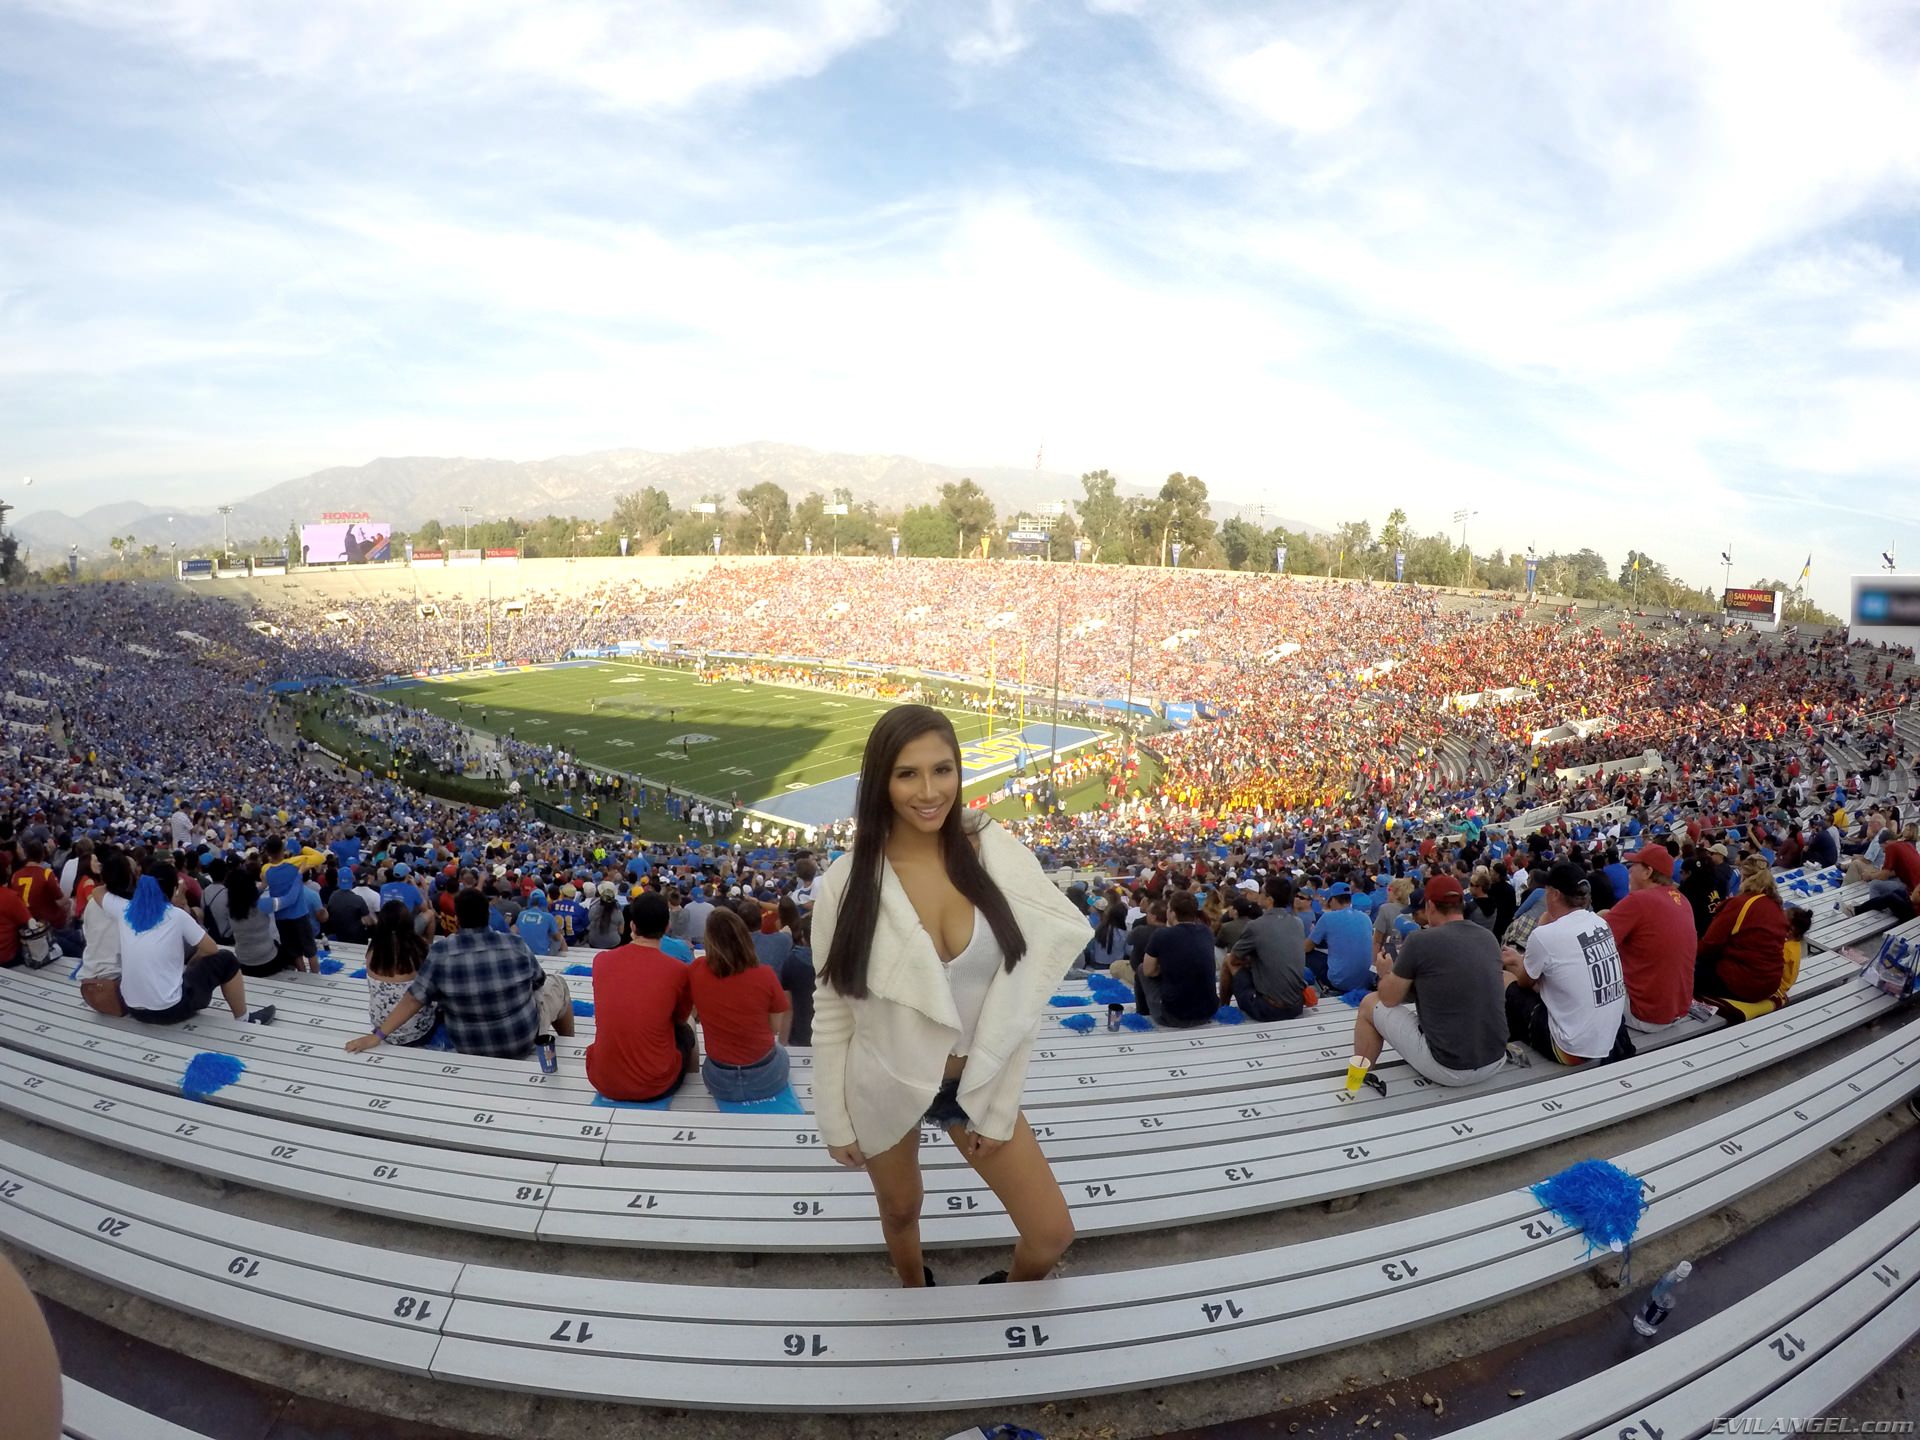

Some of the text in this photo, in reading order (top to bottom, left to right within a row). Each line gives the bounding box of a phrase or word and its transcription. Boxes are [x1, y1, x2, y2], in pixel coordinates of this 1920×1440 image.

[1734, 592, 1773, 603] SAN MANUEL
[18, 877, 33, 907] 7
[554, 903, 575, 913] UCLA
[239, 1035, 257, 1043] 23
[296, 1044, 314, 1053] 22
[1320, 1050, 1337, 1058] 10
[142, 1053, 161, 1063] 23
[366, 1056, 385, 1064] 21
[1246, 1060, 1263, 1068] 11
[441, 1065, 462, 1075] 20
[1168, 1069, 1188, 1078] 12
[23, 1077, 44, 1088] 23
[528, 1075, 548, 1084] 19
[1078, 1077, 1097, 1085] 13
[1619, 1080, 1633, 1089] 9
[284, 1083, 306, 1095] 21
[1335, 1091, 1355, 1102] 11
[93, 1099, 117, 1112] 22
[368, 1098, 392, 1110] 20
[1541, 1100, 1564, 1112] 10
[473, 1112, 495, 1124] 19
[1238, 1107, 1262, 1119] 12
[1793, 1110, 1809, 1121] 9
[1140, 1117, 1164, 1128] 13
[175, 1123, 200, 1136] 21
[580, 1125, 604, 1137] 18
[672, 1130, 697, 1142] 17
[1451, 1123, 1474, 1136] 11
[796, 1133, 821, 1145] 16
[920, 1132, 942, 1144] 15
[271, 1145, 299, 1159] 20
[1342, 1145, 1371, 1160] 12
[1719, 1140, 1743, 1156] 10
[373, 1165, 400, 1180] 19
[1224, 1166, 1254, 1182] 13
[0, 1180, 24, 1198] 21
[515, 1186, 545, 1201] 18
[1085, 1183, 1116, 1199] 14
[627, 1194, 658, 1209] 17
[947, 1195, 978, 1210] 15
[792, 1201, 824, 1216] 16
[97, 1216, 130, 1238] 20
[1519, 1219, 1554, 1240] 12
[228, 1256, 261, 1279] 19
[1381, 1259, 1419, 1282] 13
[1872, 1264, 1900, 1288] 11
[393, 1296, 433, 1322] 18
[1200, 1299, 1244, 1323] 14
[549, 1320, 593, 1344] 17
[1005, 1325, 1049, 1348] 15
[783, 1334, 829, 1357] 16
[1768, 1332, 1806, 1361] 12
[1618, 1418, 1665, 1440] 13
